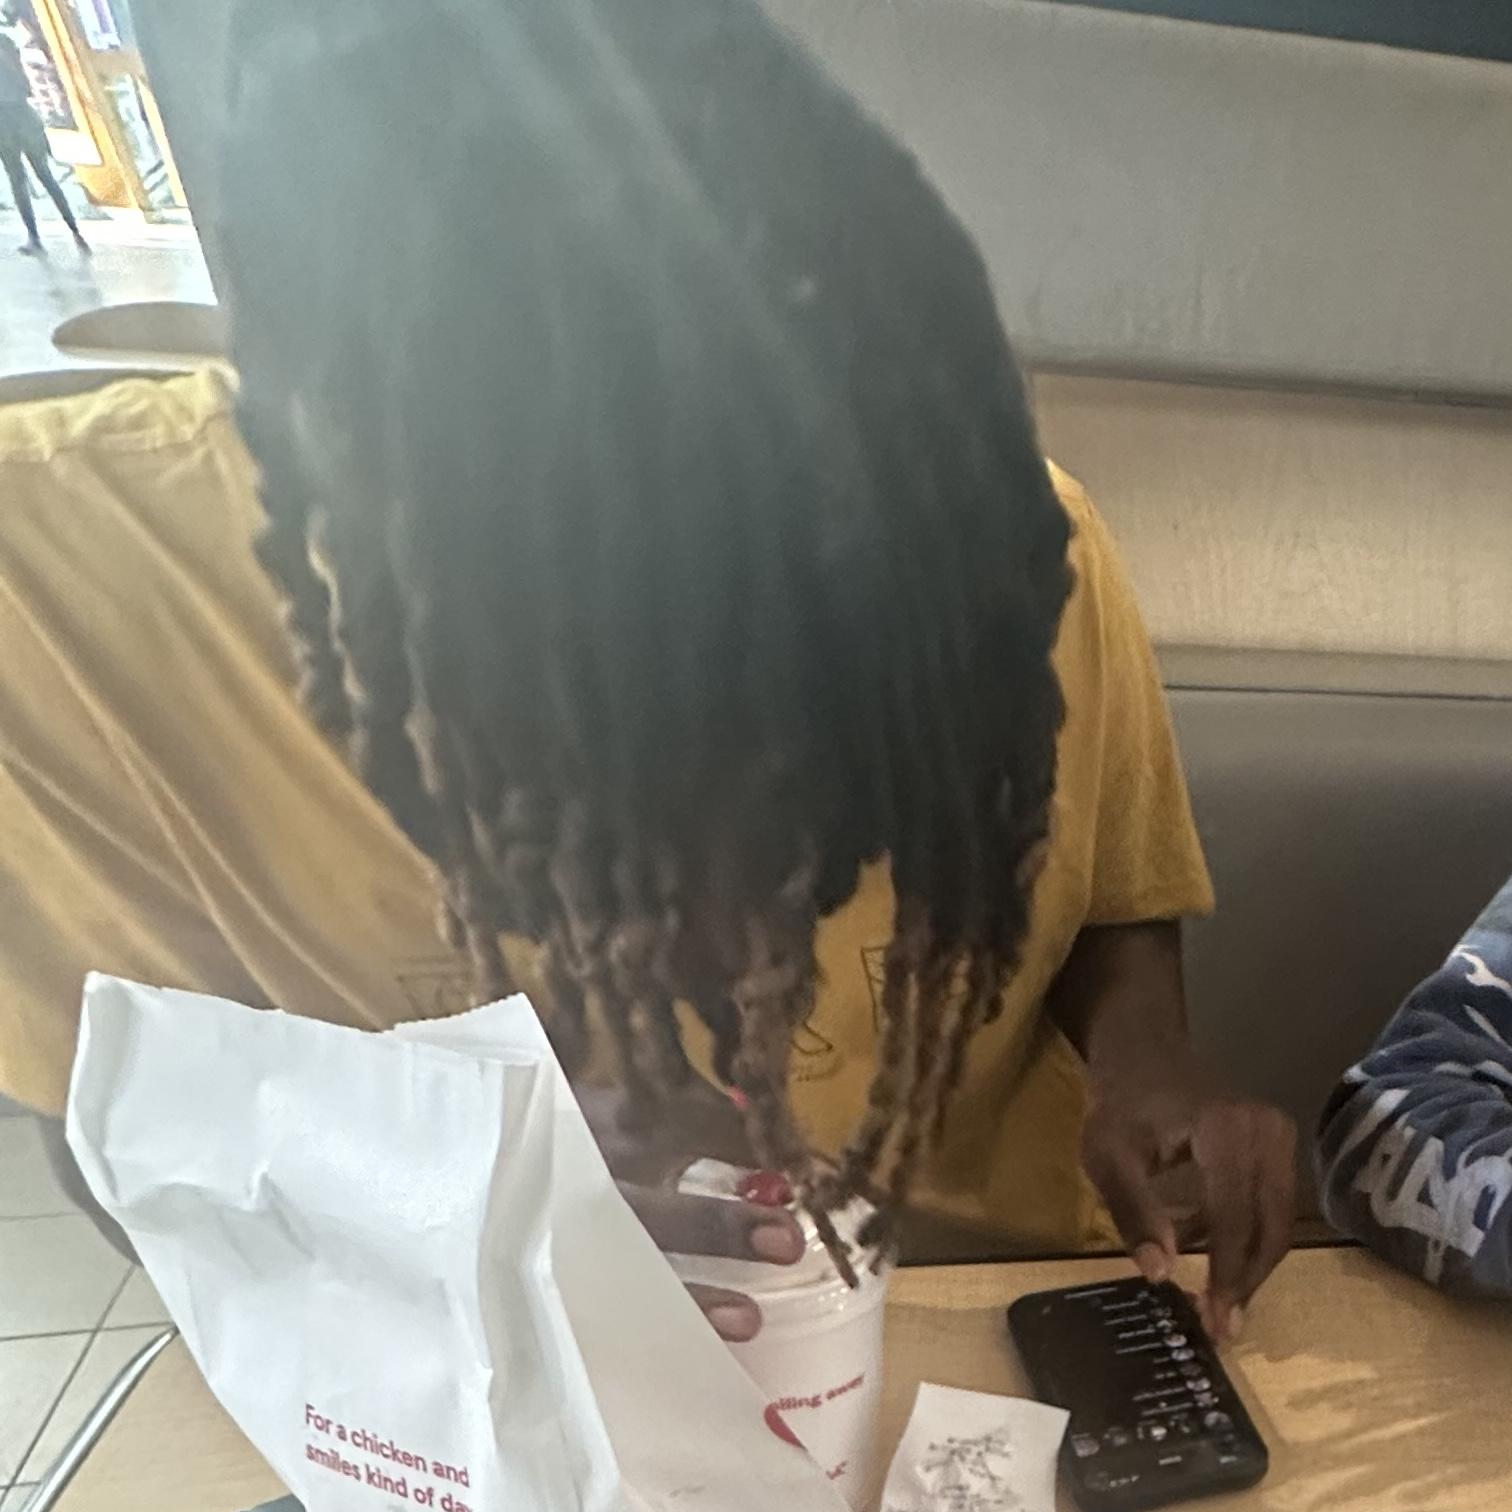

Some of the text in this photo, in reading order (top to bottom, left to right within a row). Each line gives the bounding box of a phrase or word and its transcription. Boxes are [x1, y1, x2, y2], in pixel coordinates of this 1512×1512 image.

[305, 1402, 470, 1488] For a chicken and
[306, 1444, 361, 1481] smiles
[365, 1463, 409, 1498] kind
[414, 1486, 434, 1507] of
